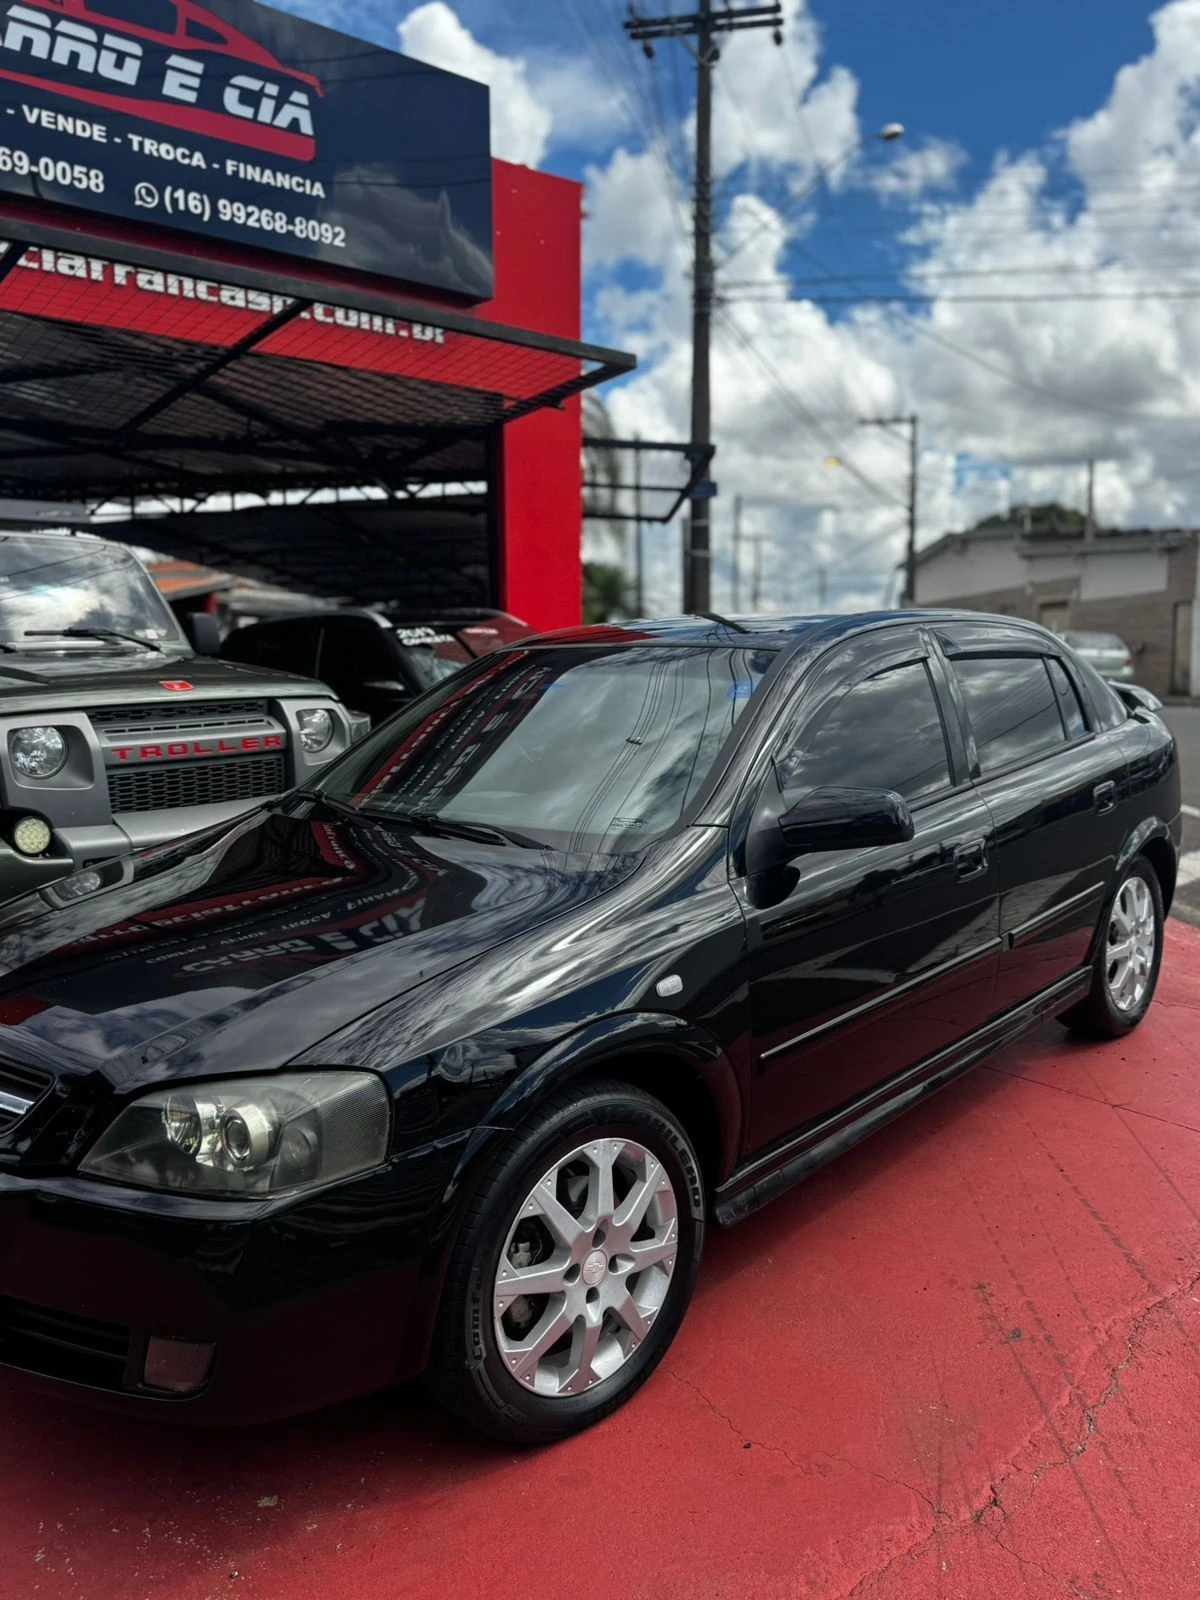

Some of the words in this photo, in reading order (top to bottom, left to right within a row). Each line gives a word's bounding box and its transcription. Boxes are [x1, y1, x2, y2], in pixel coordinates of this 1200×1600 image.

[0, 4, 144, 86] RRO
[161, 54, 204, 104] E
[22, 104, 108, 143] VENDE
[127, 133, 207, 169] TROCA
[225, 159, 326, 198] FINANCIA
[164, 185, 211, 222] (16)
[217, 198, 346, 248] 99268-8092
[111, 735, 281, 761] TROLLER
